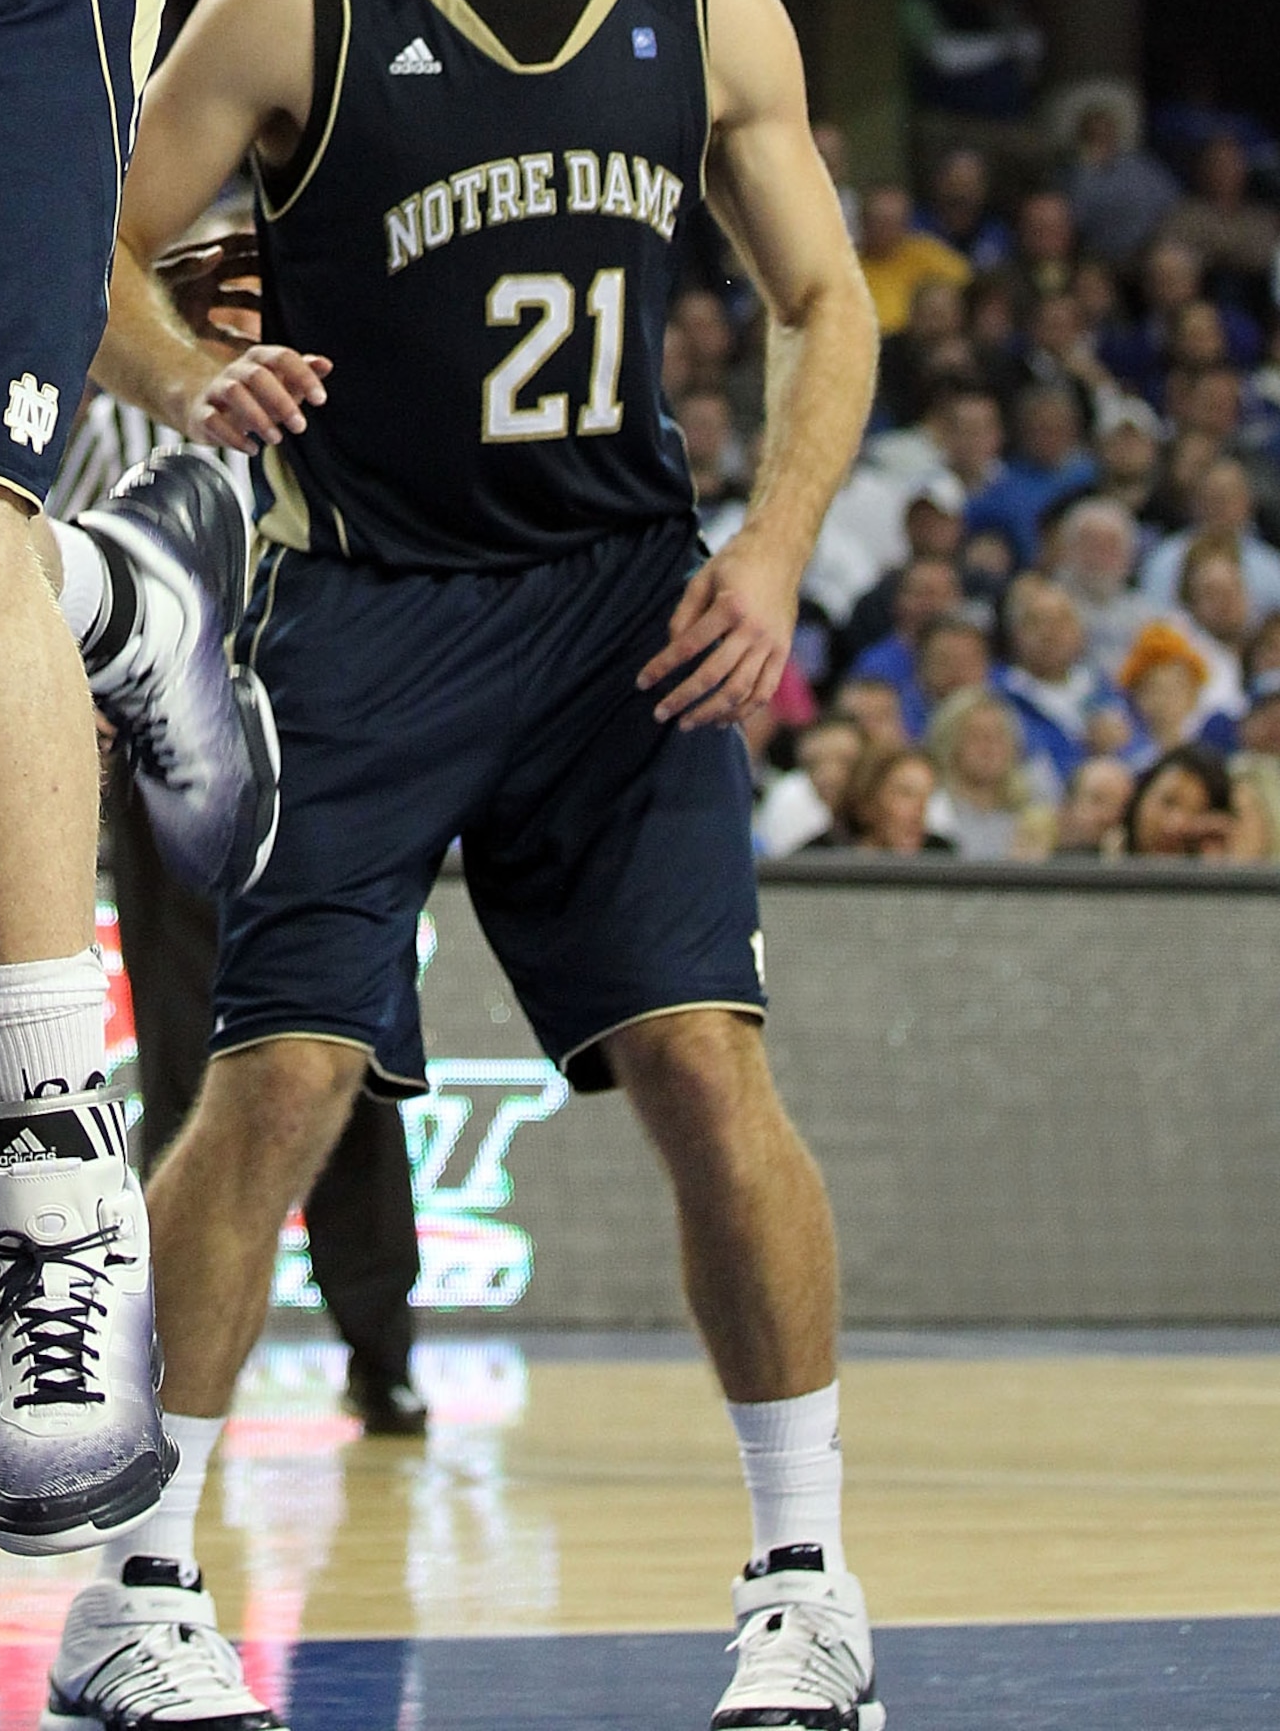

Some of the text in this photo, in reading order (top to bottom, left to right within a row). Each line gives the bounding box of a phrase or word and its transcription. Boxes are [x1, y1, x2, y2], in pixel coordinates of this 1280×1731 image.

[389, 59, 443, 75] adidas
[384, 149, 684, 276] NOTRE DAME
[481, 267, 626, 444] 21
